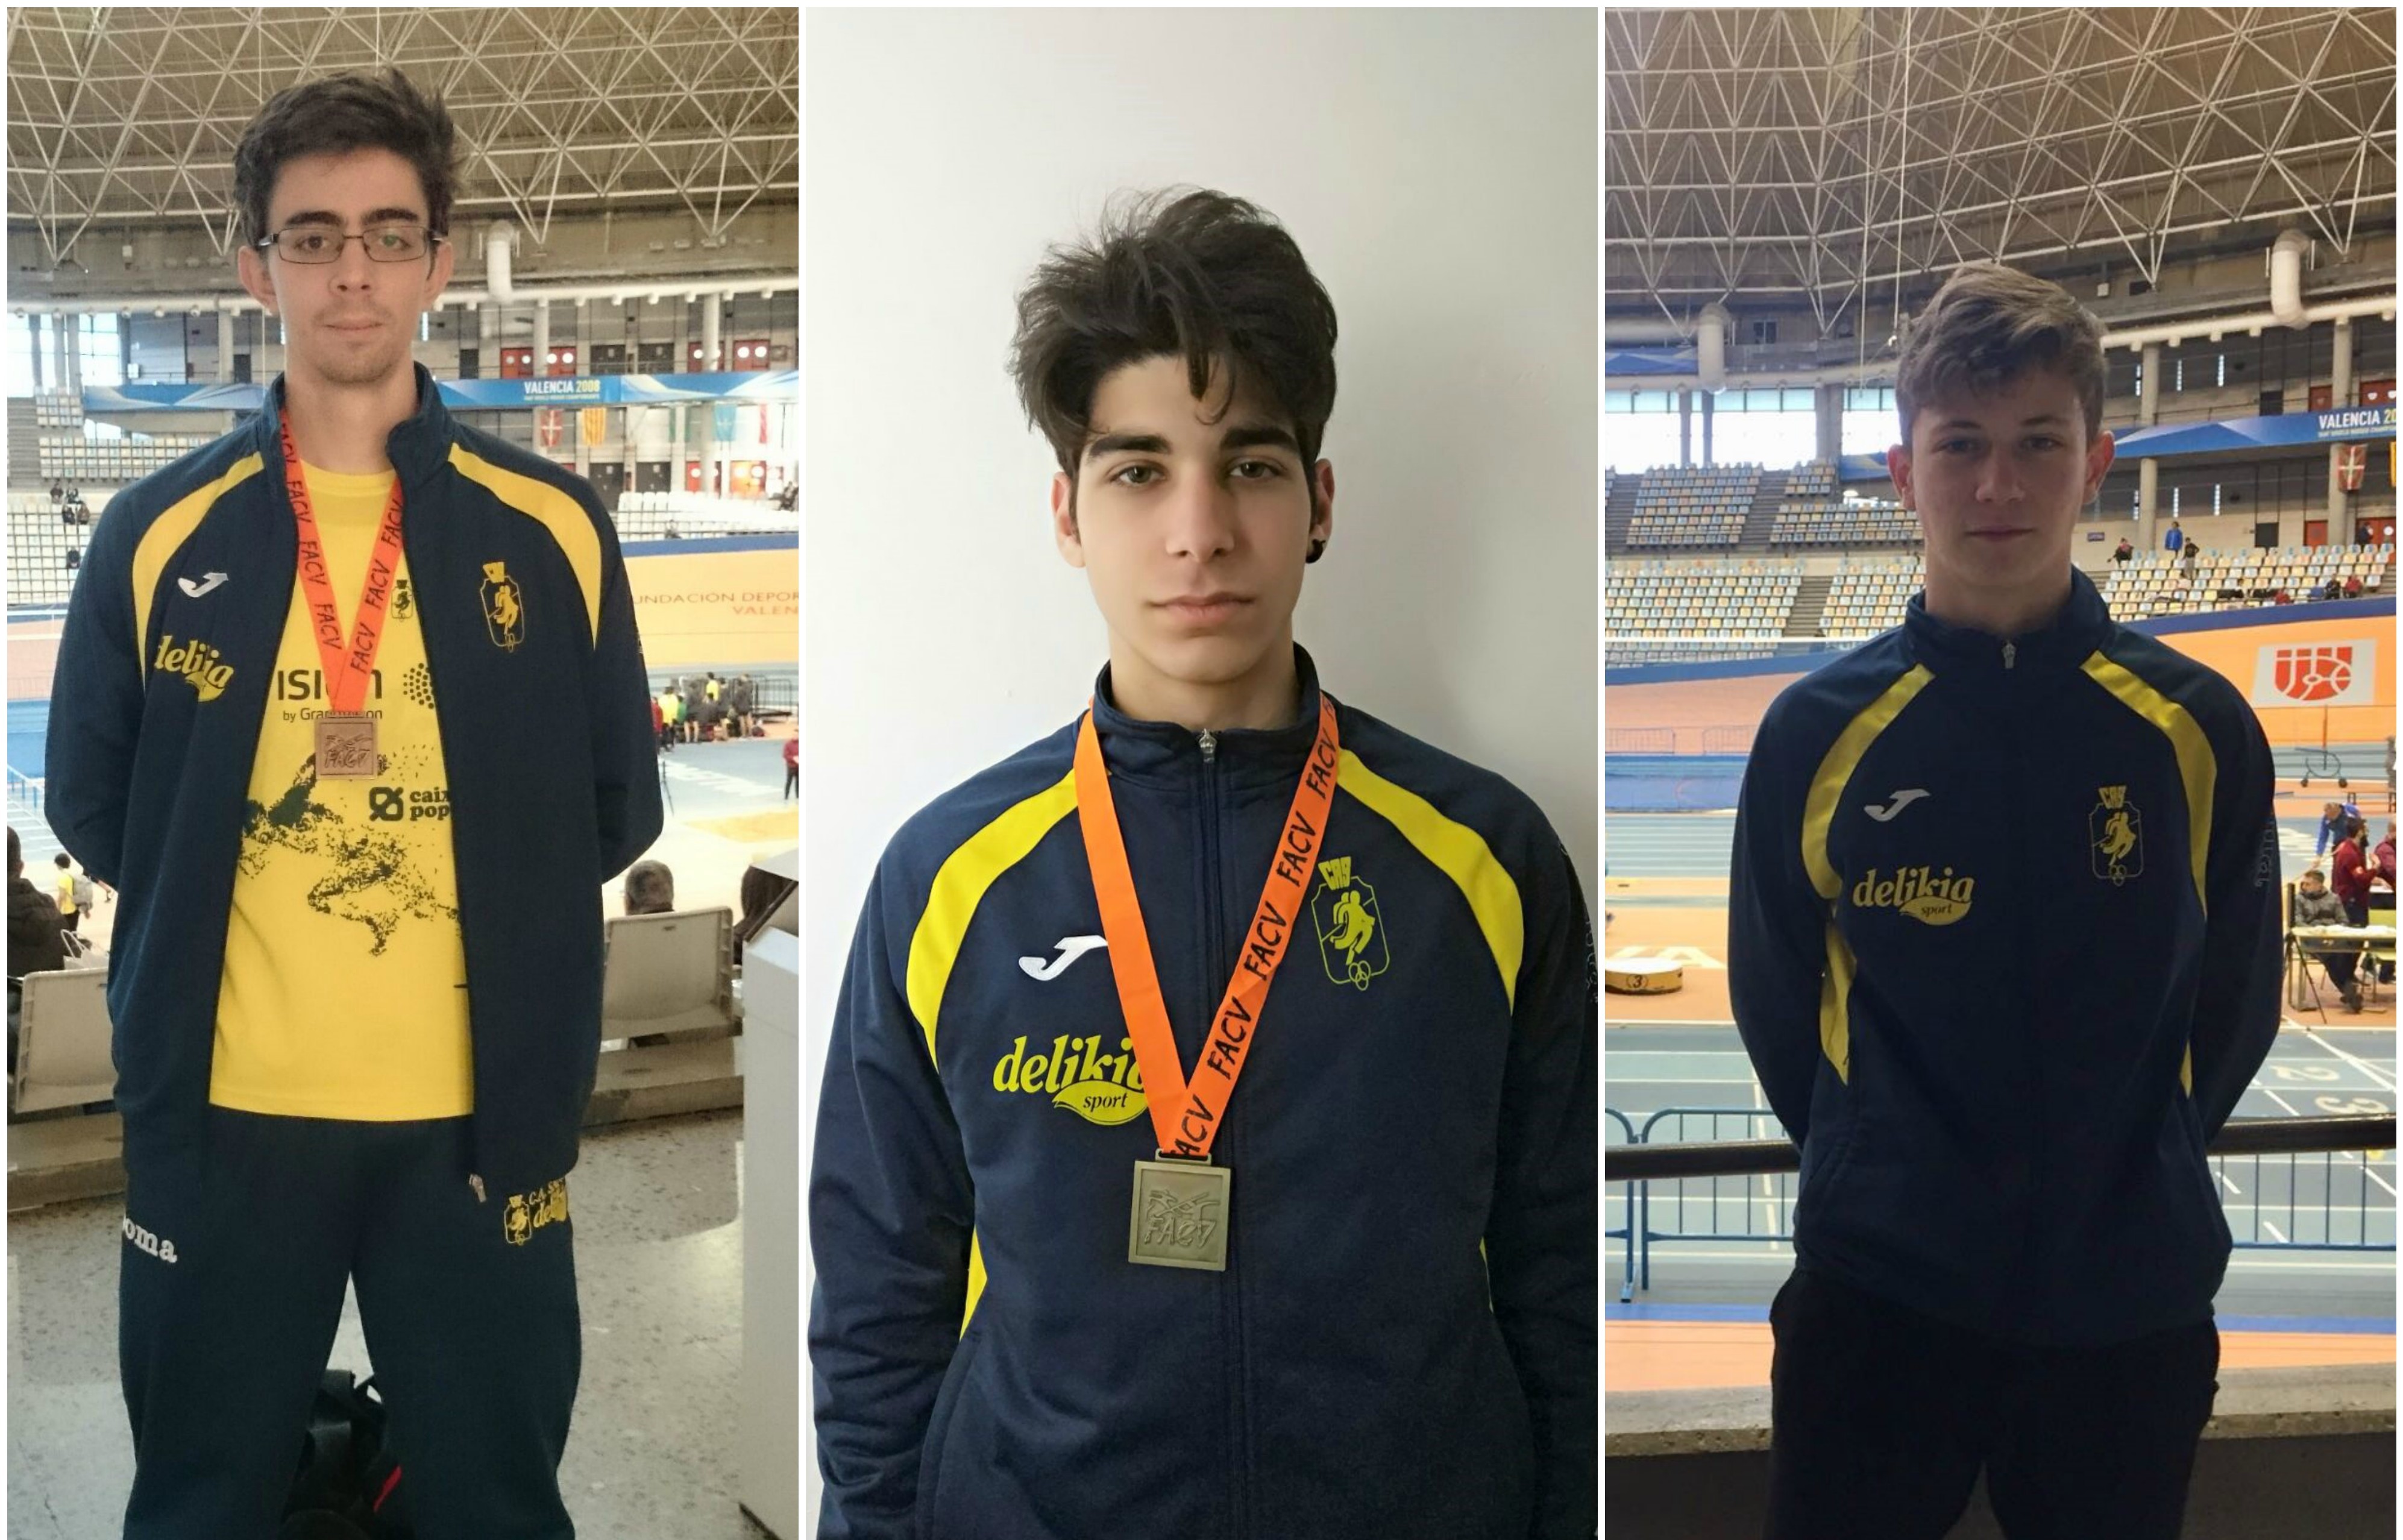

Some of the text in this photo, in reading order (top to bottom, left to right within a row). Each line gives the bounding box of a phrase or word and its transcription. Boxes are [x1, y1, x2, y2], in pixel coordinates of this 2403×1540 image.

[524, 380, 573, 394] VALENCIA
[2319, 410, 2380, 429] VALENCIA
[301, 541, 327, 586] FACV
[365, 559, 389, 610] FACV
[315, 603, 342, 650] FACV
[351, 622, 375, 674] FACV
[283, 710, 296, 723] by
[1305, 727, 1336, 800] FACV
[1276, 810, 1316, 888] FACV
[1853, 866, 1974, 907] delikia
[1921, 904, 1953, 917] sport
[1244, 900, 1287, 981] FACV
[1207, 996, 1252, 1080] FACV
[1082, 1093, 1128, 1113] sport
[1170, 1093, 1214, 1155] ACV
[123, 1213, 177, 1263] oma
